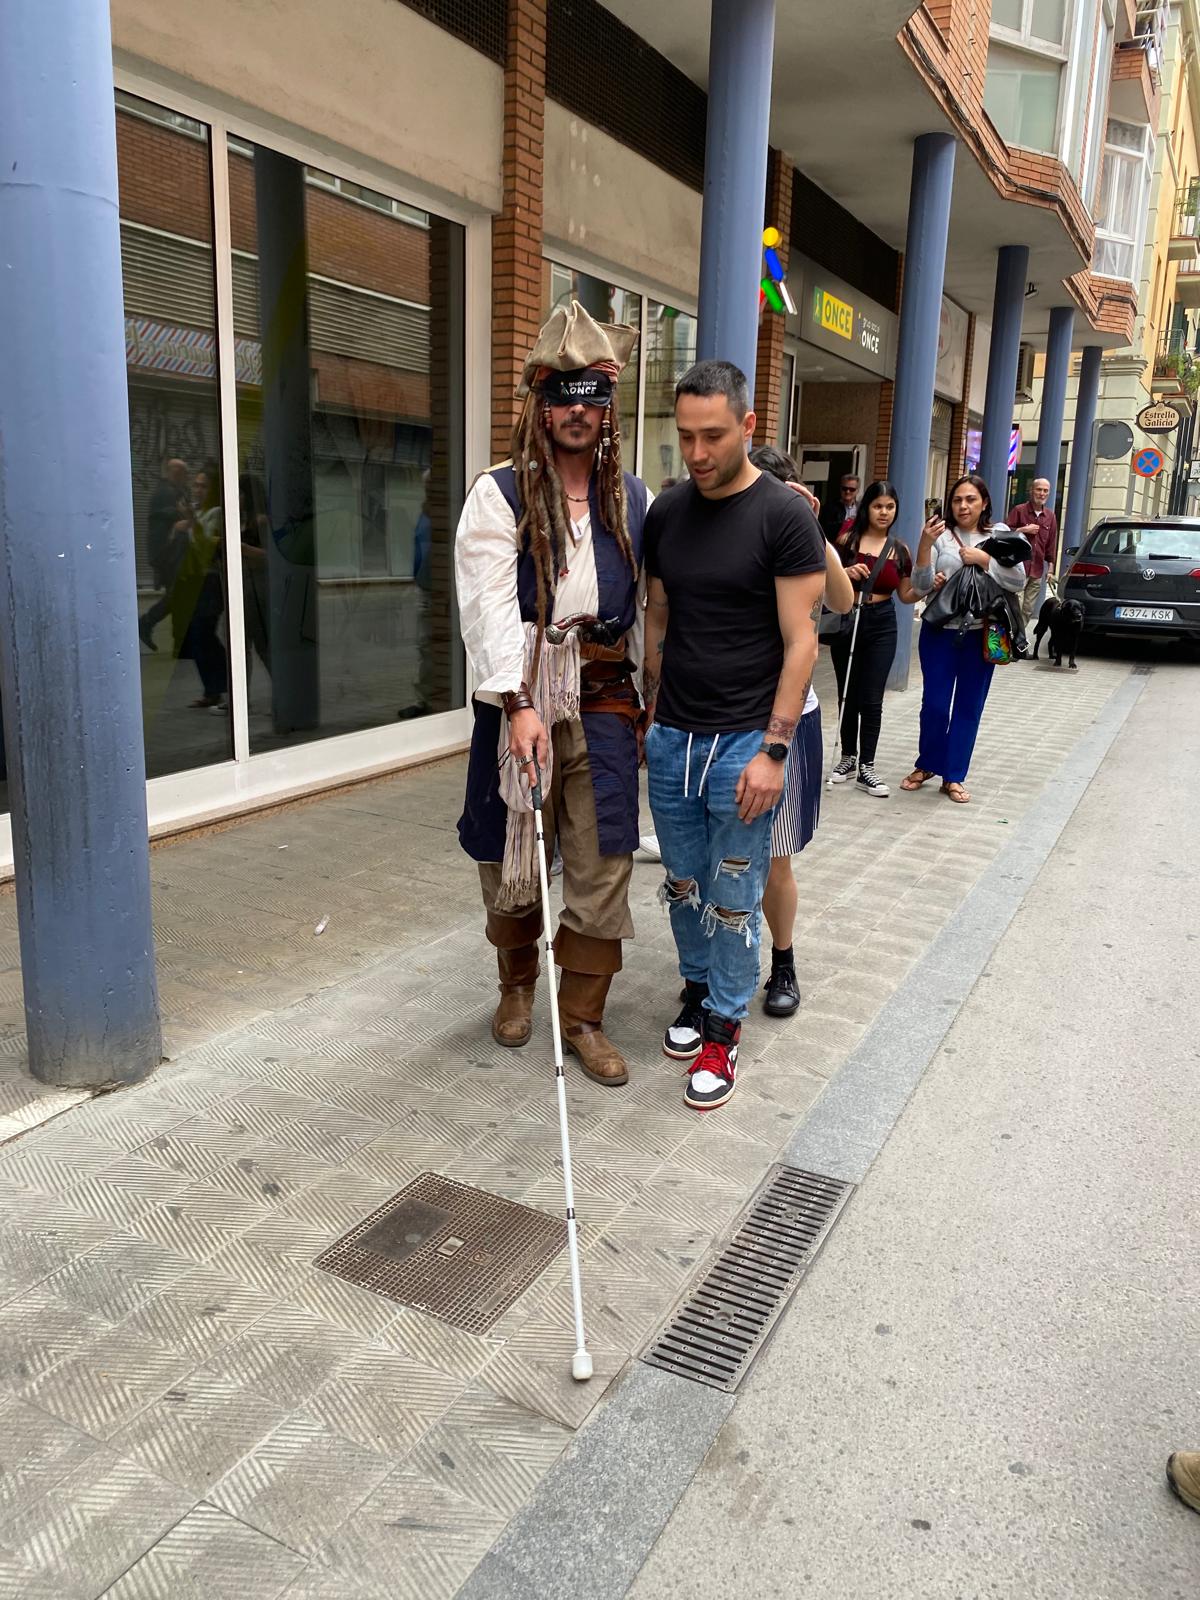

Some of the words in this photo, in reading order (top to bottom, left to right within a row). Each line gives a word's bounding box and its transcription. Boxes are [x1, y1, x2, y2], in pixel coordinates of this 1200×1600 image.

[825, 300, 851, 333] ONCE
[862, 330, 880, 354] ONCE
[570, 386, 597, 395] ONCE
[1144, 411, 1176, 419] Estrella
[1144, 419, 1173, 427] Galicia
[1122, 607, 1147, 618] 4374
[1151, 610, 1171, 620] KSK
